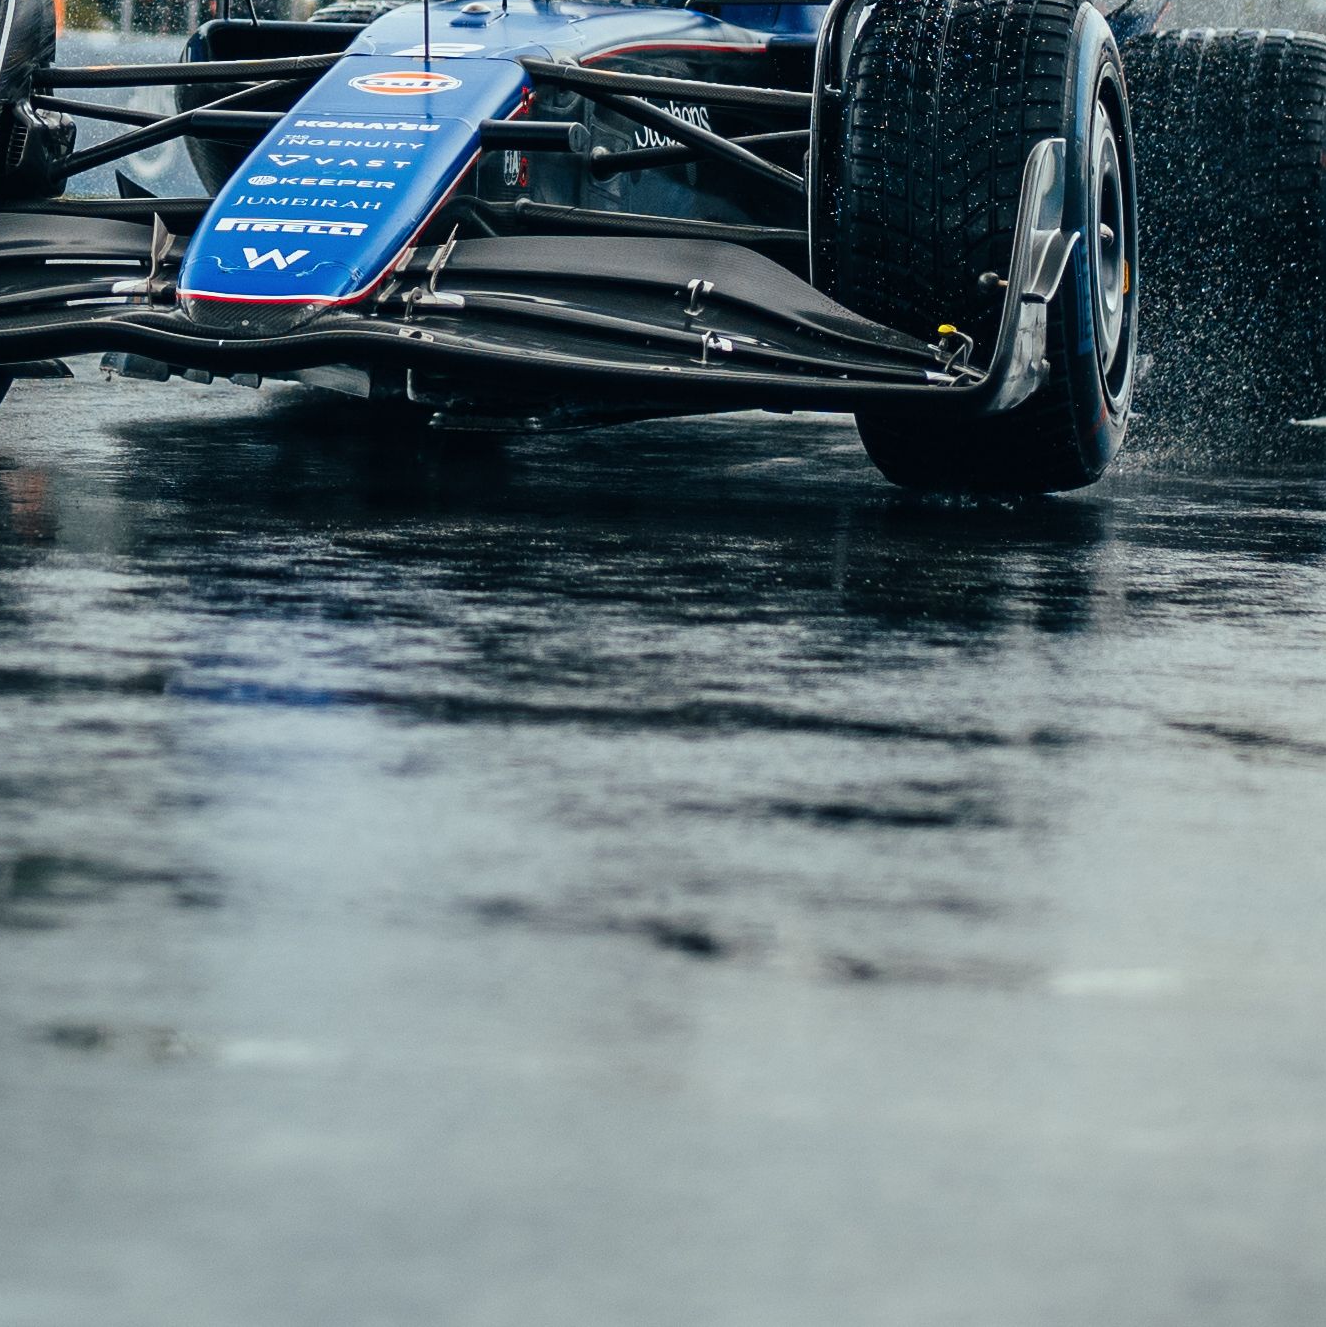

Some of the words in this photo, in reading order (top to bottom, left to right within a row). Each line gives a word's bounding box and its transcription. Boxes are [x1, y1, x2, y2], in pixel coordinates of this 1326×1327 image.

[293, 119, 441, 132] KOMATSU
[277, 138, 426, 150] INGENUITY
[315, 158, 412, 169] VAST
[280, 177, 396, 189] KEEPER
[232, 195, 383, 211] JUMEIRAH
[214, 217, 369, 236] PIRELLI
